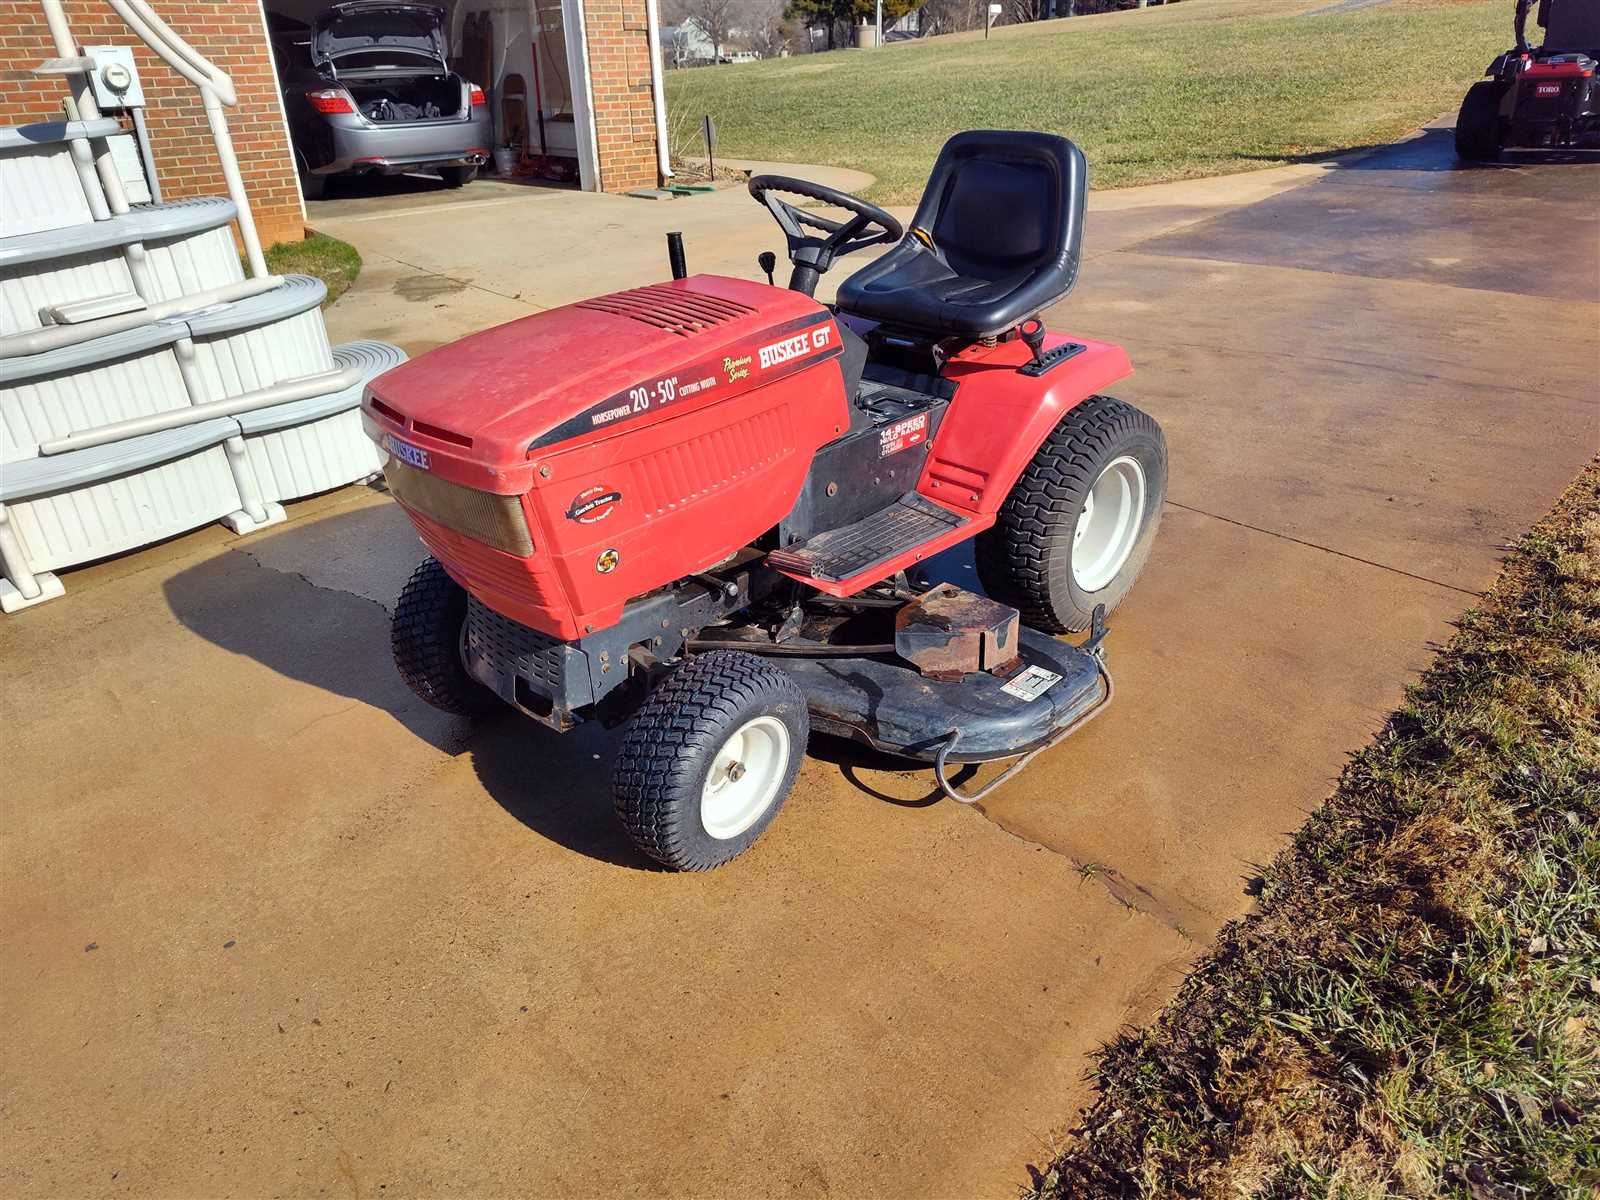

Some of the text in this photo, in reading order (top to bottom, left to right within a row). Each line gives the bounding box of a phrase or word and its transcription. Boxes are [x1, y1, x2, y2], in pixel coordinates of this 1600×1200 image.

[758, 326, 830, 369] HUSKEE GT
[723, 355, 752, 372] Premium
[591, 376, 716, 426] HORSEPOWER 20 50" CUTTING WIDTH
[880, 415, 925, 438] 14-SPEED
[901, 423, 925, 436] RANGE
[388, 436, 429, 470] HUSKEE
